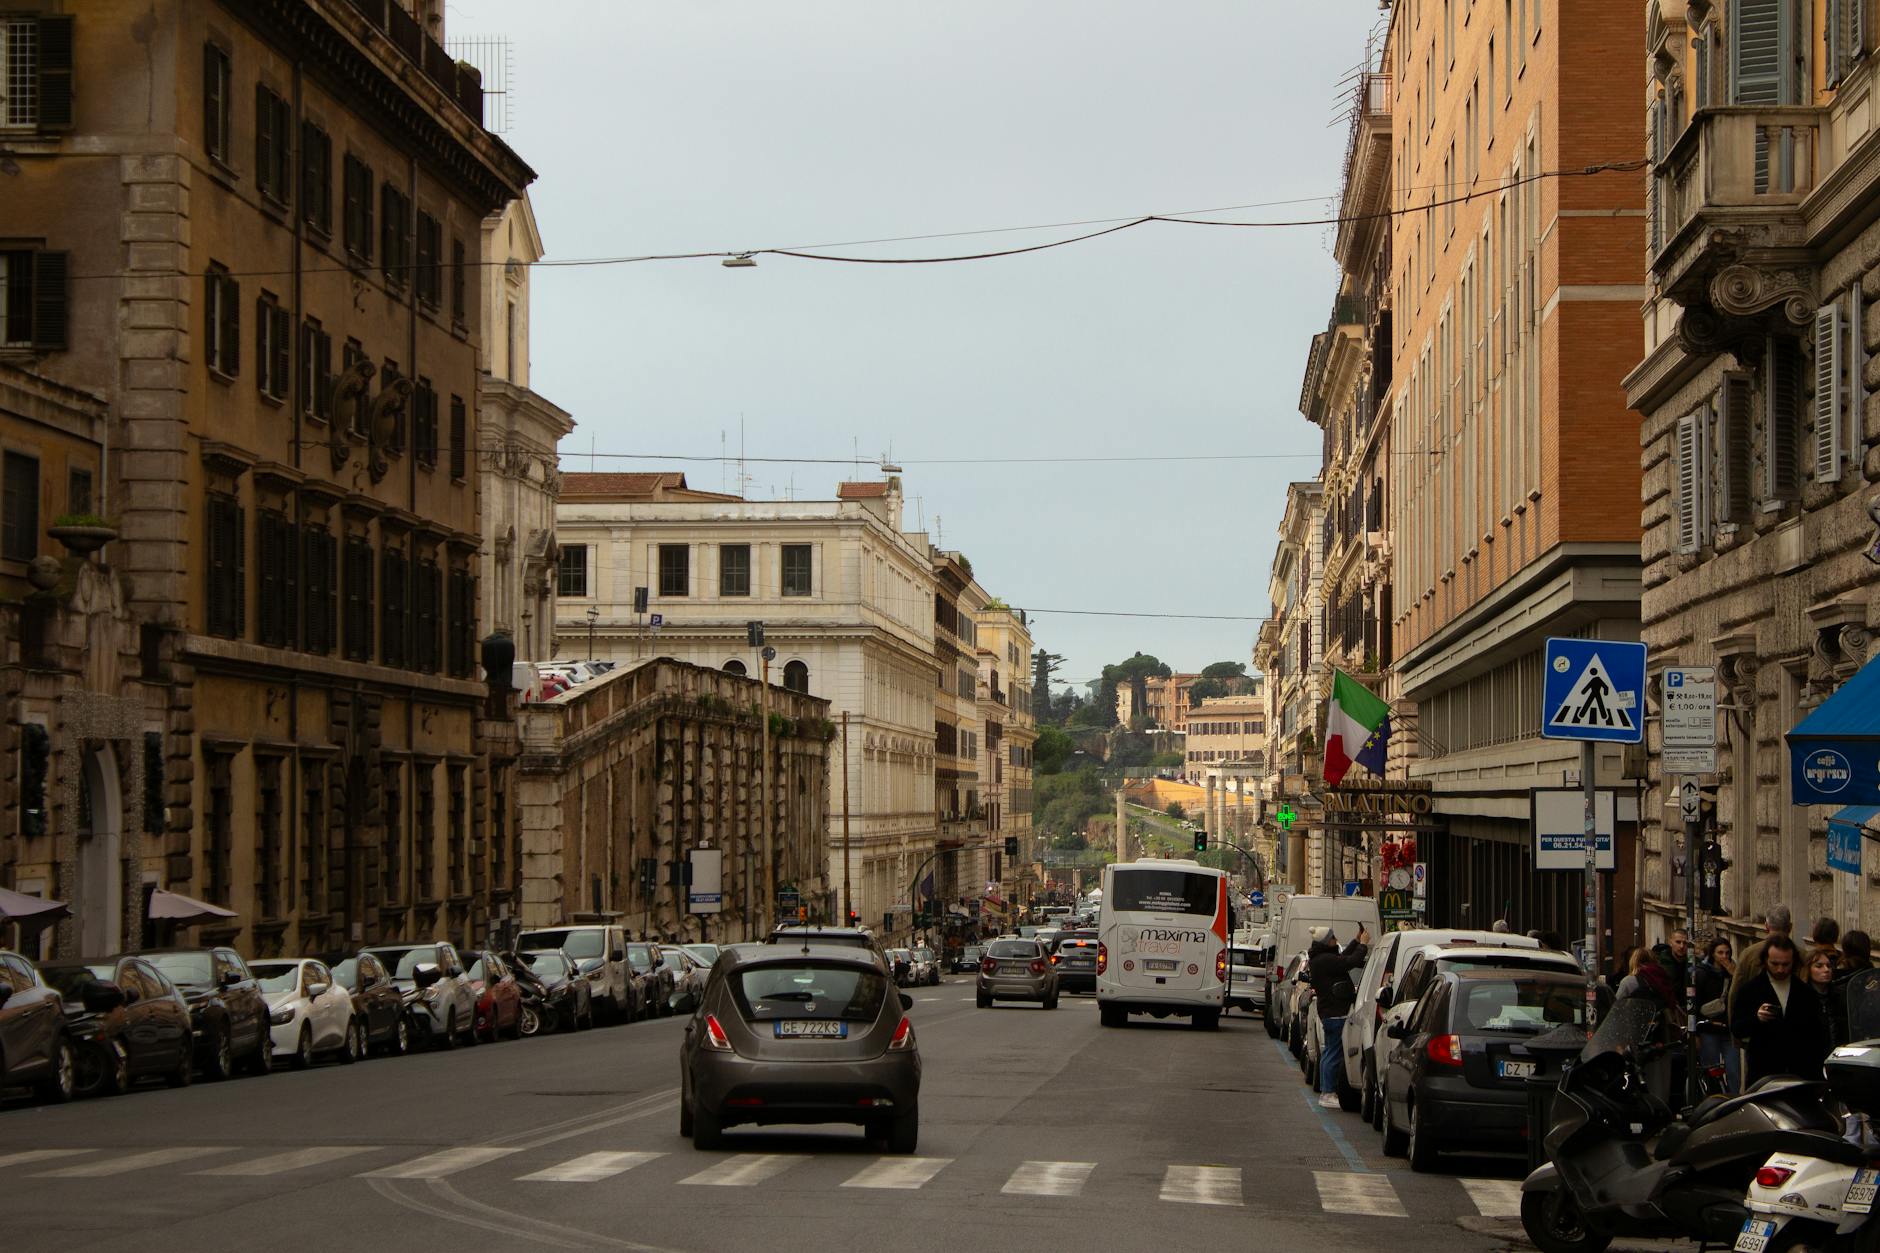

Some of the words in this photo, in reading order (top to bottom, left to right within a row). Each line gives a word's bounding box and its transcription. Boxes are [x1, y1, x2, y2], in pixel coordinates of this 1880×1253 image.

[1671, 673, 1681, 686] P
[1323, 793, 1432, 814] PALATINO
[1140, 928, 1206, 943] maxima
[1136, 939, 1182, 954] travel
[801, 1022, 839, 1034] 722KS
[1506, 1063, 1521, 1076] CZ
[1750, 1221, 1760, 1235] EL
